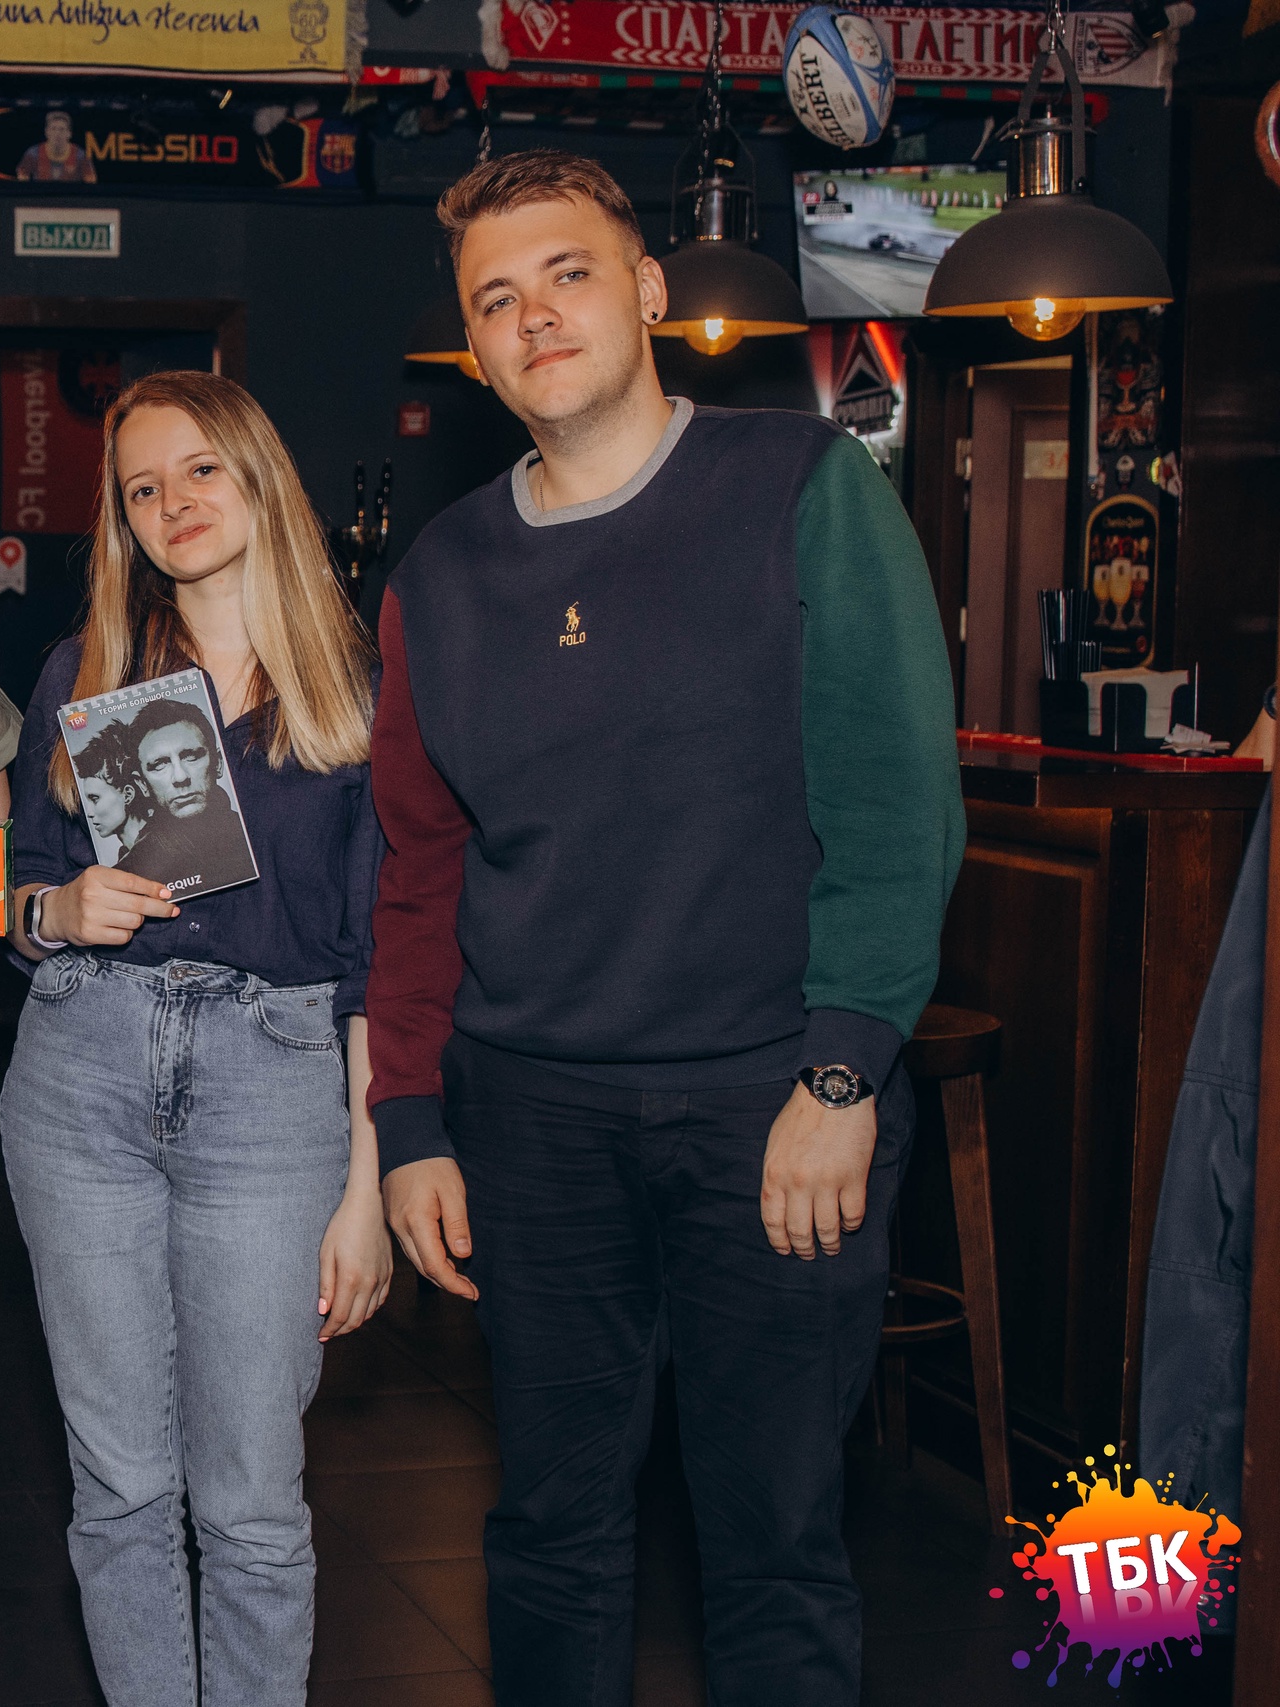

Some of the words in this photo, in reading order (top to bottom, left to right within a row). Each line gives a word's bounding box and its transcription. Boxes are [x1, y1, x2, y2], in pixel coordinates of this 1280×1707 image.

[614, 6, 792, 54] СПАРТА
[884, 19, 1048, 64] ТЛЕТИК
[25, 226, 112, 252] ВЫХОД
[559, 632, 586, 647] POLO
[98, 702, 127, 716] ТЕОРИЯ
[129, 690, 171, 707] БОЛЬШОГО
[173, 683, 198, 696] КВИЗА
[69, 716, 86, 727] ТБК
[166, 875, 203, 892] GQIUZ
